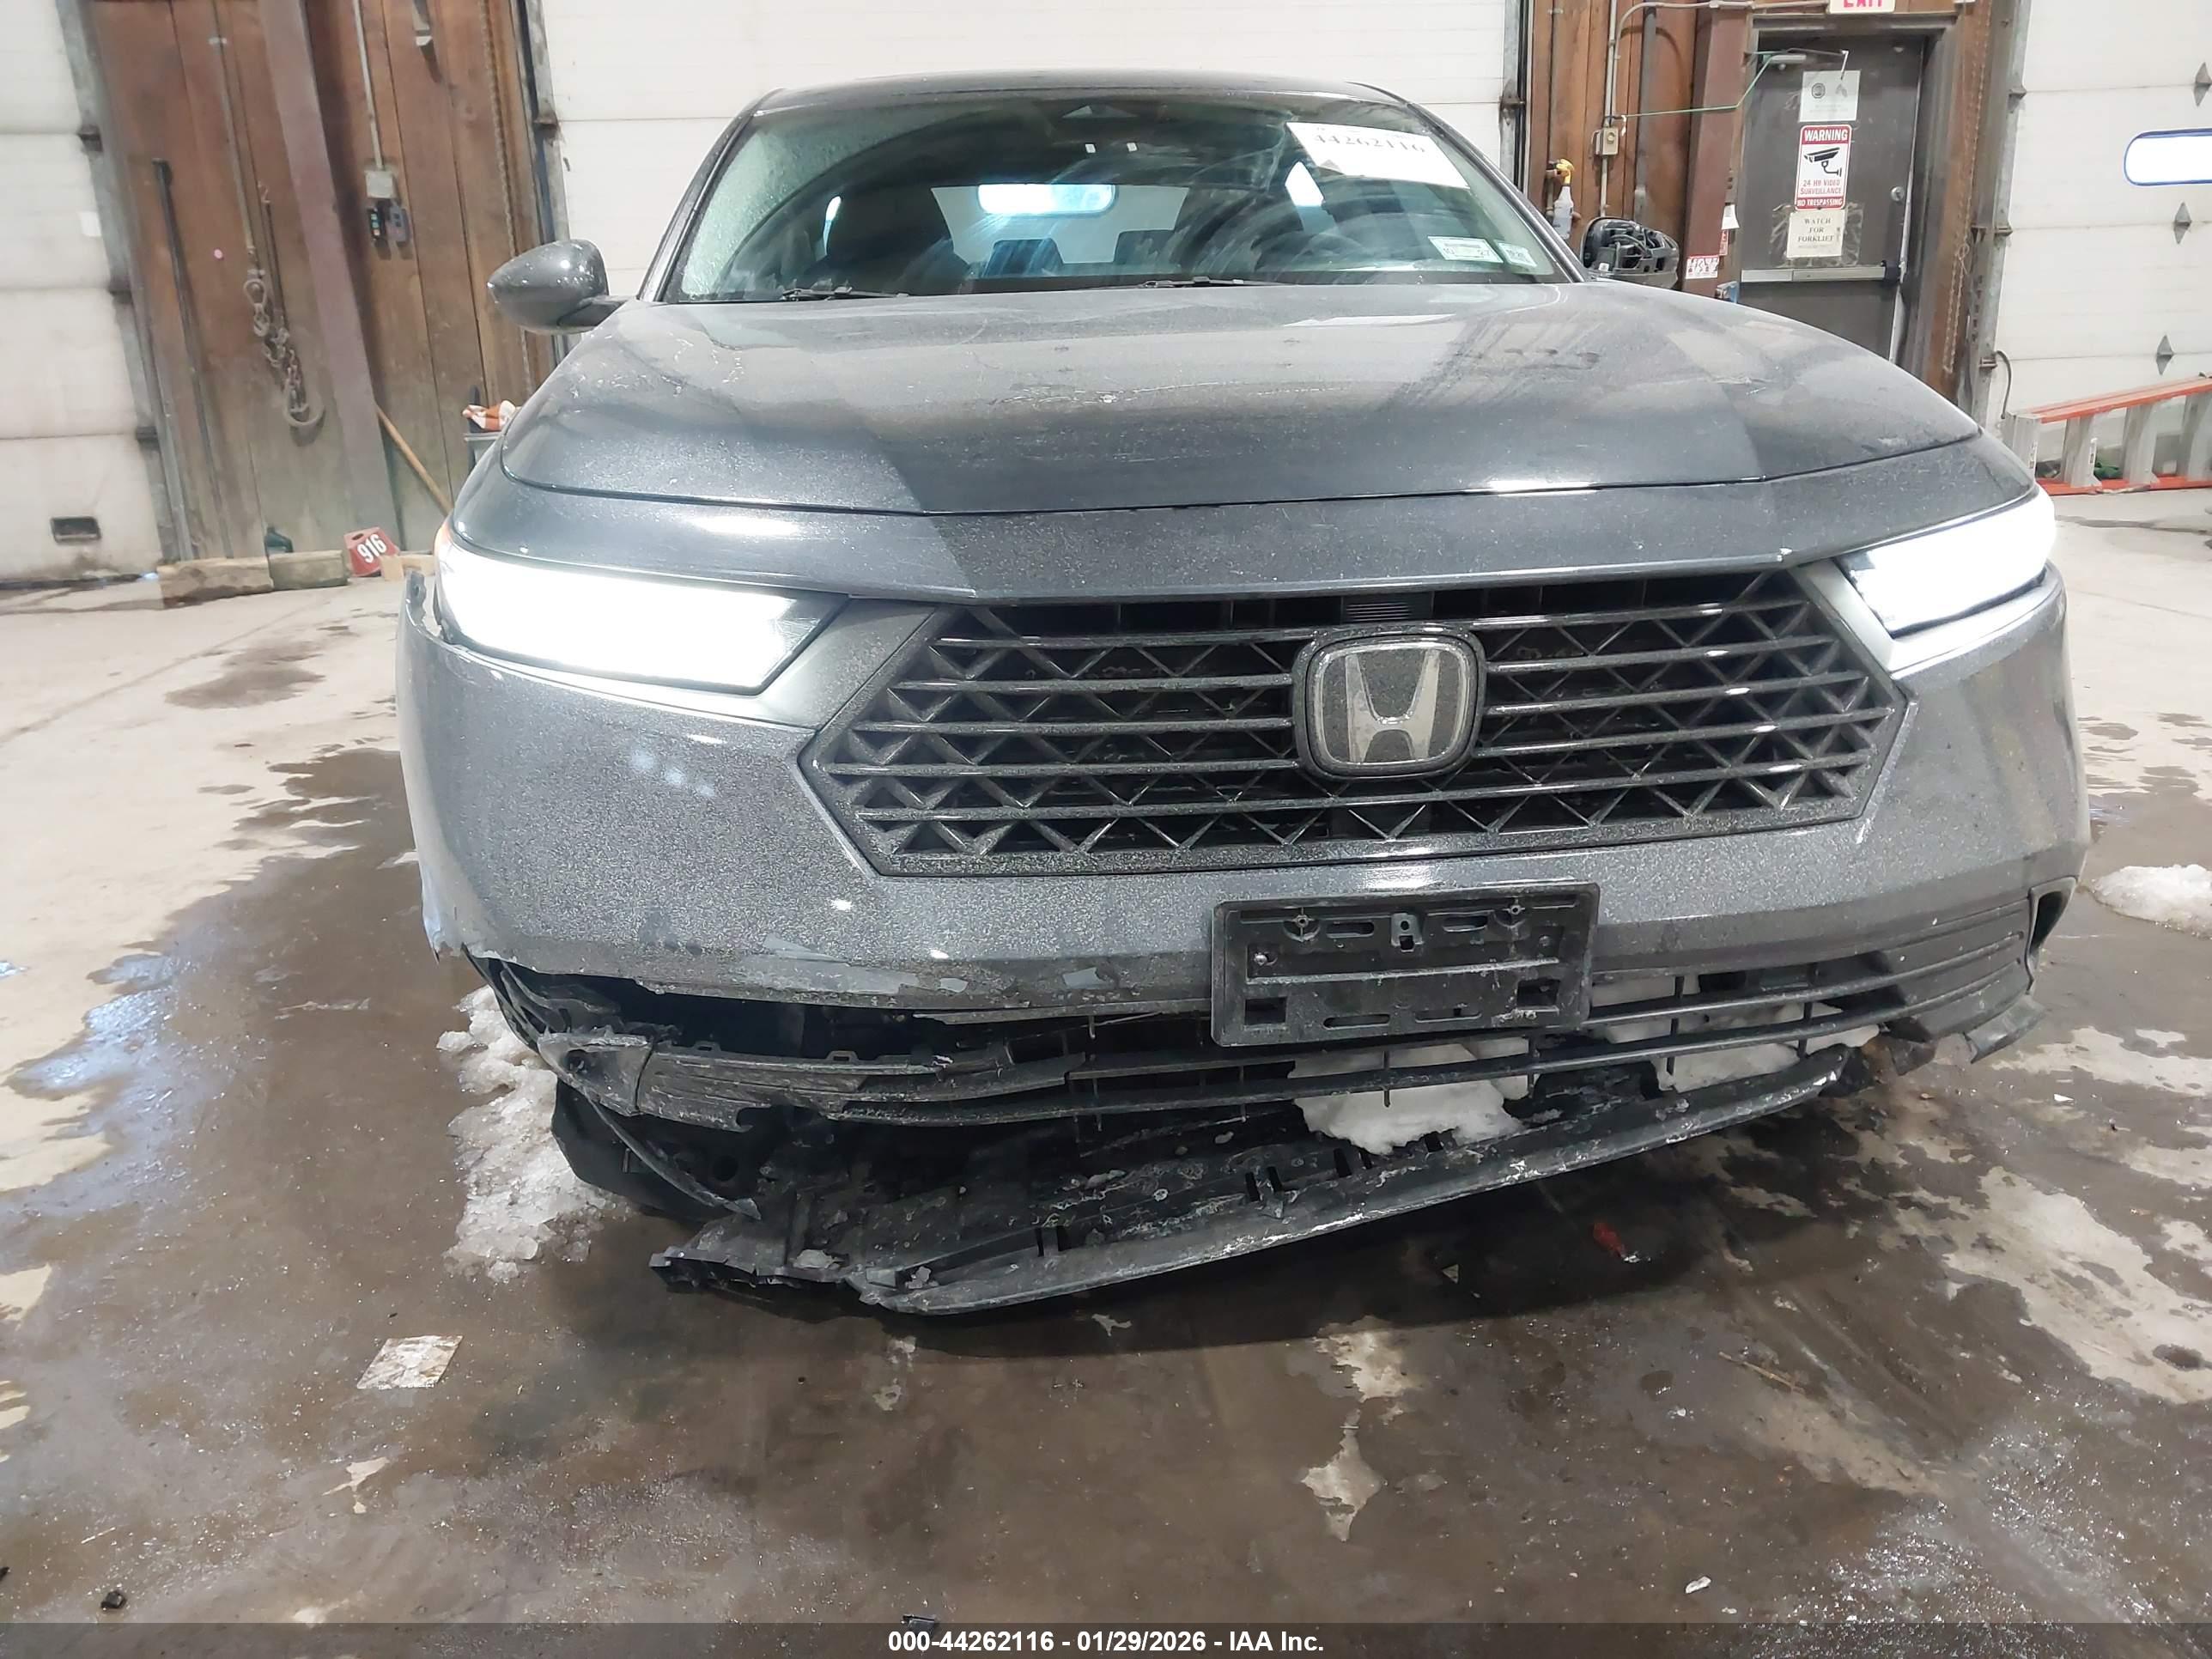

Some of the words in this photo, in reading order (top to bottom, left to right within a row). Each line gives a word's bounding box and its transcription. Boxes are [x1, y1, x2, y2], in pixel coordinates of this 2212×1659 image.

[1804, 129, 1848, 142] WARNING
[1807, 198, 1843, 207] TRESPASSING
[357, 533, 387, 563] 916
